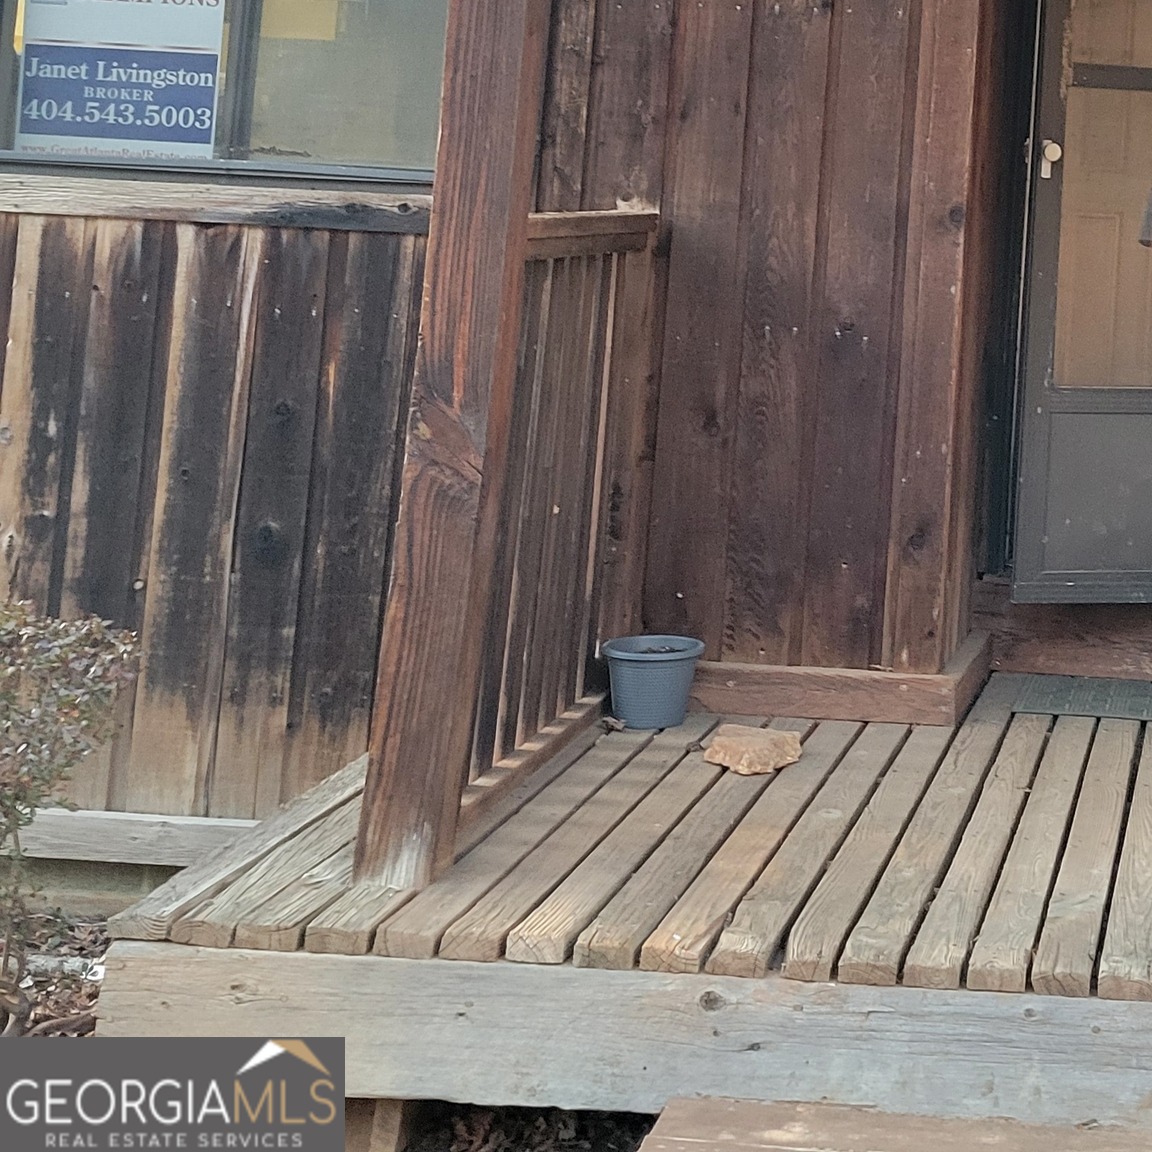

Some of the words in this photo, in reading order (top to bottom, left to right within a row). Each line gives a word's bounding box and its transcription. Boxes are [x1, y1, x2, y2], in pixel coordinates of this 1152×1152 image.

[24, 56, 90, 80] Janet
[94, 60, 215, 89] Livingston
[83, 86, 154, 102] BROKER
[23, 98, 212, 130] 404.543.5003
